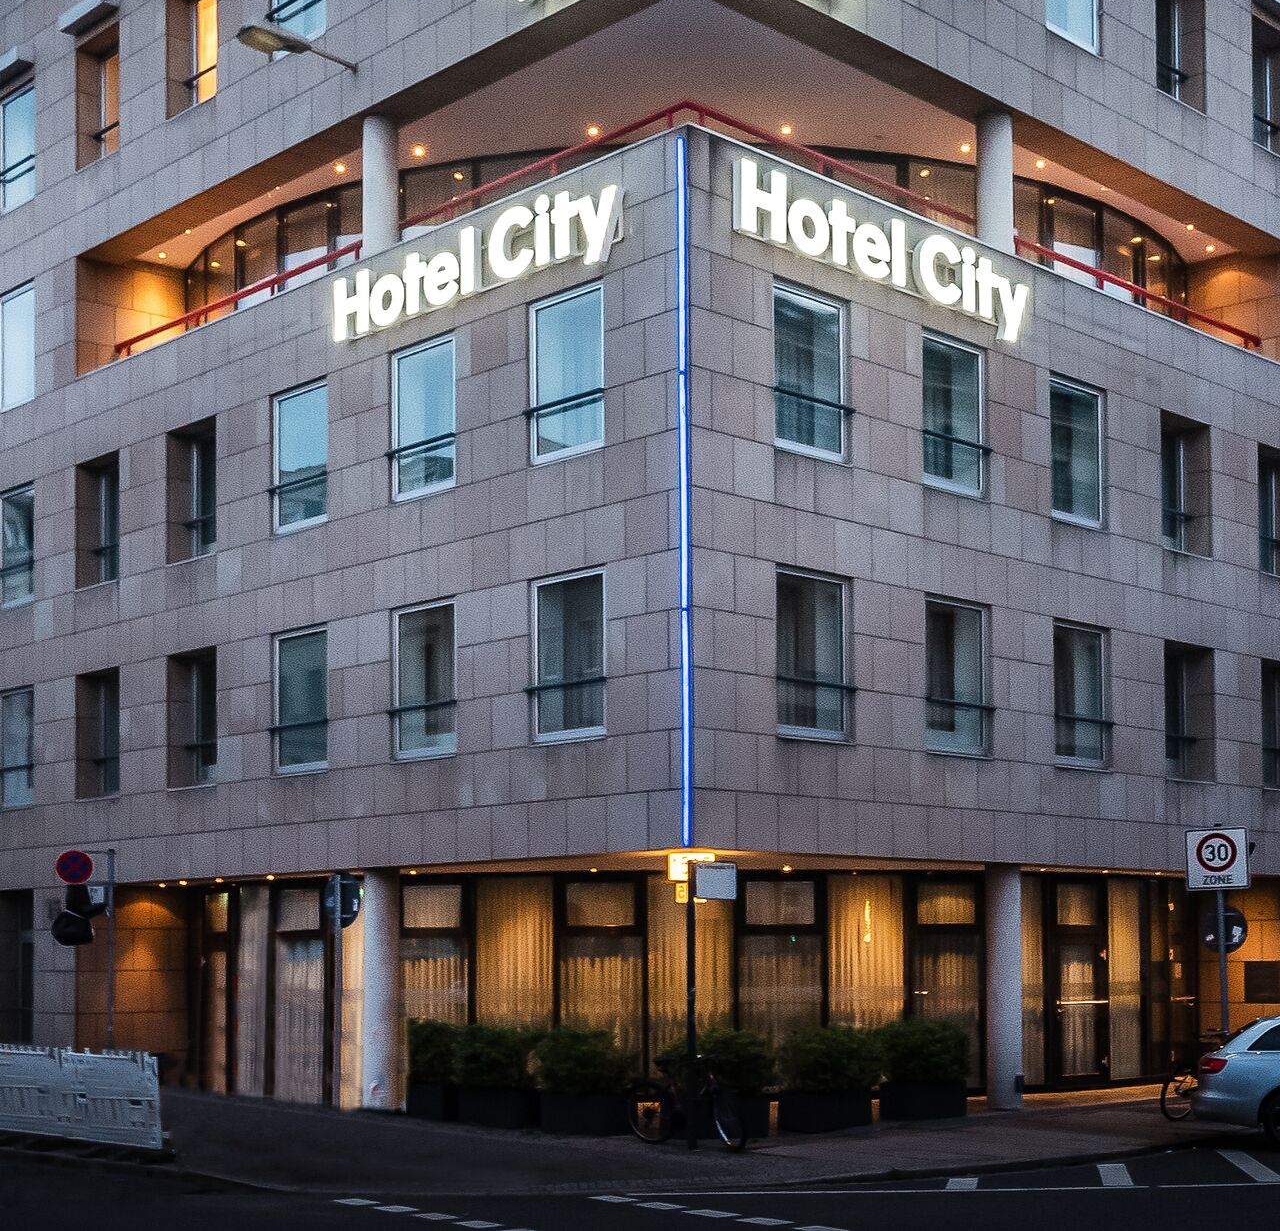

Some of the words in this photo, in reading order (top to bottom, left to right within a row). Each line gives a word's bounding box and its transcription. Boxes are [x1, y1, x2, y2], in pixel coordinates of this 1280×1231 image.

[331, 225, 478, 344] Hotel
[488, 184, 619, 280] City
[736, 156, 907, 289] Hotel
[914, 233, 1030, 343] City
[1203, 875, 1233, 885] ZONE
[1205, 844, 1228, 861] 30
